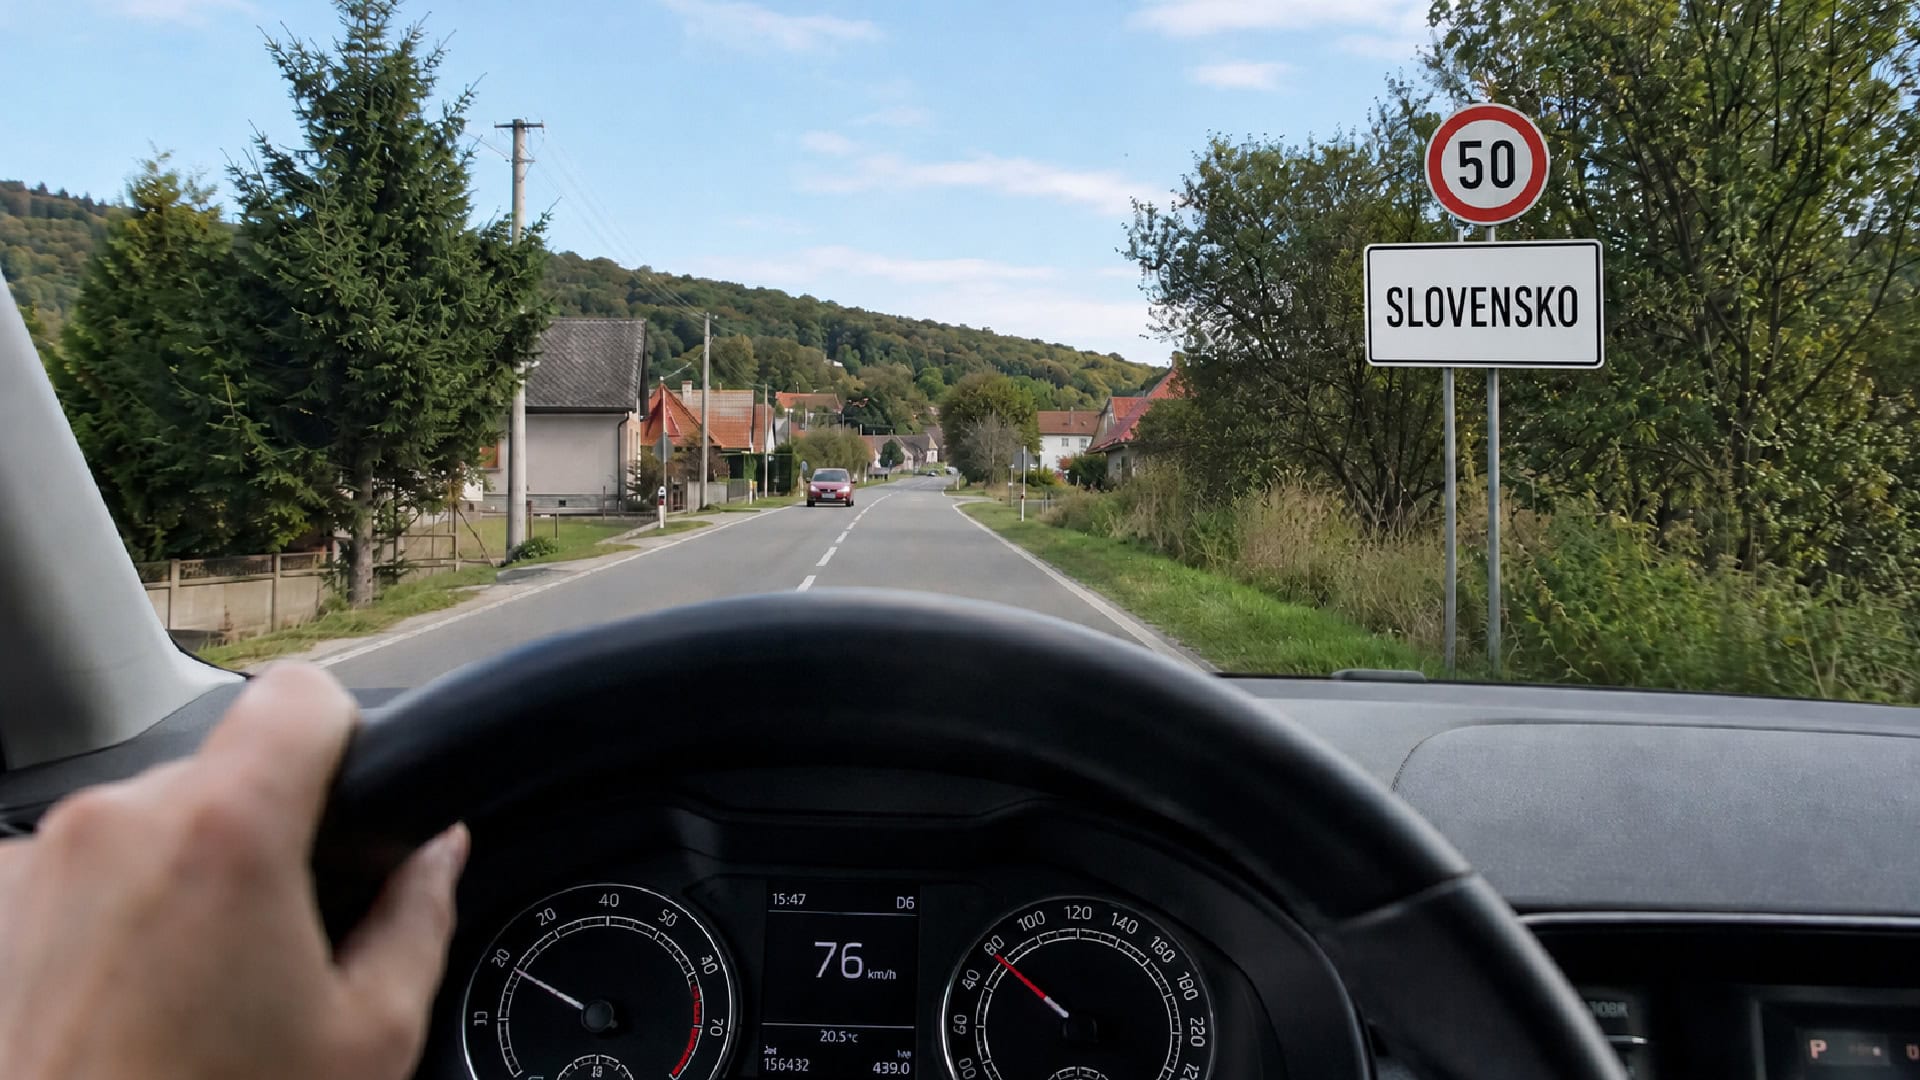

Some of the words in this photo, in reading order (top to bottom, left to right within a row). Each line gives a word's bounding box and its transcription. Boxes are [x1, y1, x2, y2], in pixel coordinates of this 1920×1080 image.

[1457, 140, 1516, 190] 50
[1386, 286, 1578, 328] SLOVENSKO
[598, 893, 620, 908] 40
[772, 893, 806, 905] 15:47
[896, 896, 915, 910] D6
[535, 907, 558, 927] 20
[658, 908, 679, 928] 50
[1016, 910, 1046, 932] 100
[1064, 905, 1092, 920] 120
[1111, 912, 1139, 935] 140
[983, 934, 1005, 956] 80
[490, 948, 511, 968] 20
[814, 941, 864, 979] 76
[867, 969, 897, 981] km/h
[709, 1018, 724, 1037] 70
[1190, 1016, 1206, 1048] 220
[764, 1057, 809, 1072] 156432
[872, 1062, 910, 1075] 439.0
